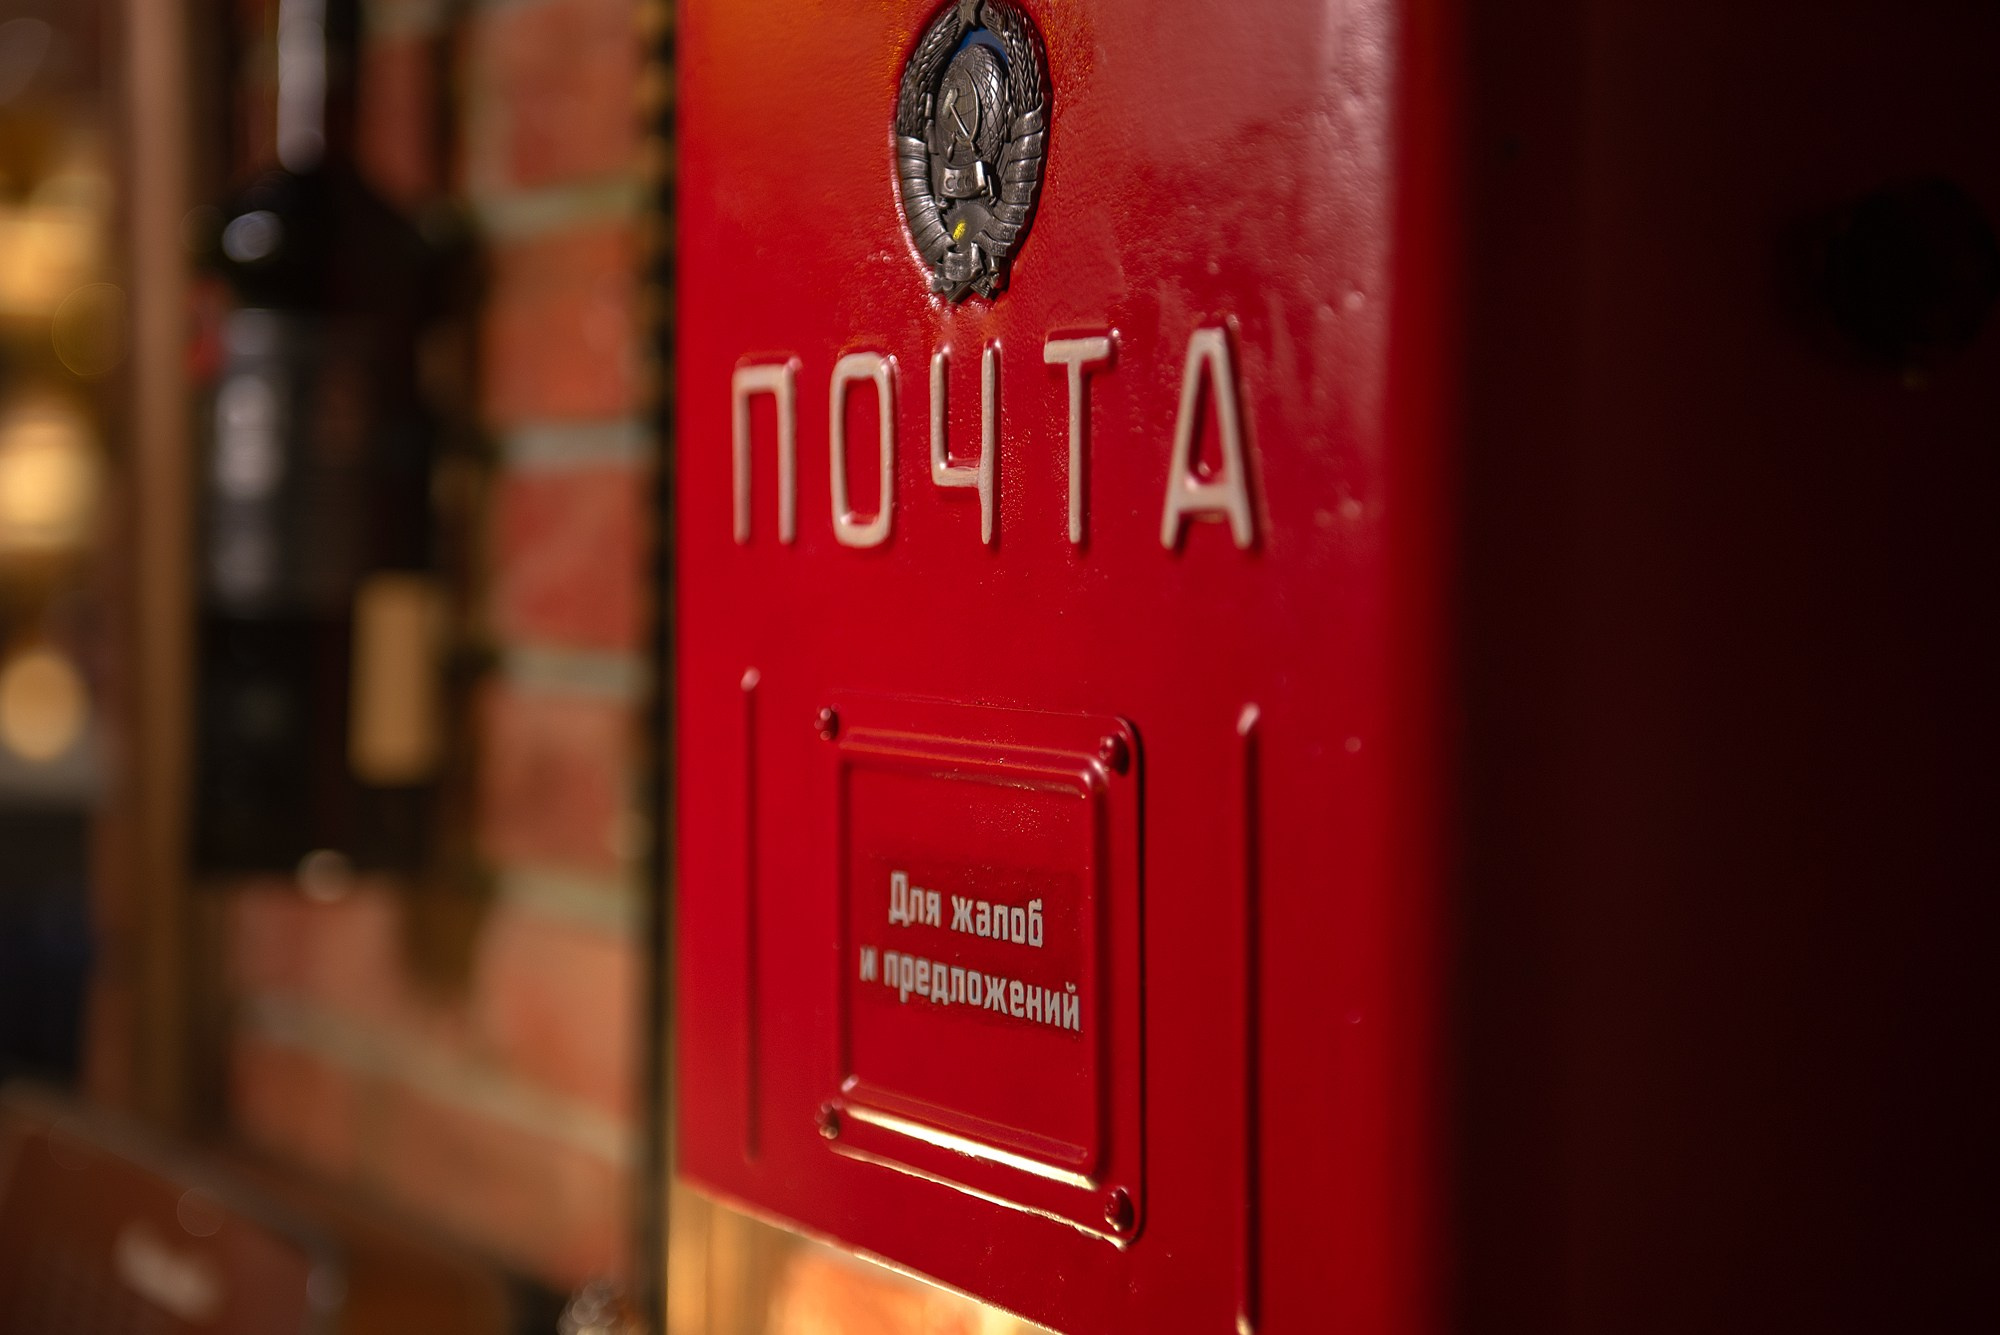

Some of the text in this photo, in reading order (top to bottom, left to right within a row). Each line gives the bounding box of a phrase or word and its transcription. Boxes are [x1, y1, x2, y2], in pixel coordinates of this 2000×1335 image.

[731, 327, 1255, 549] ПОЧТА
[888, 871, 1043, 948] Для жалоб
[859, 946, 1080, 1032] и предложений
